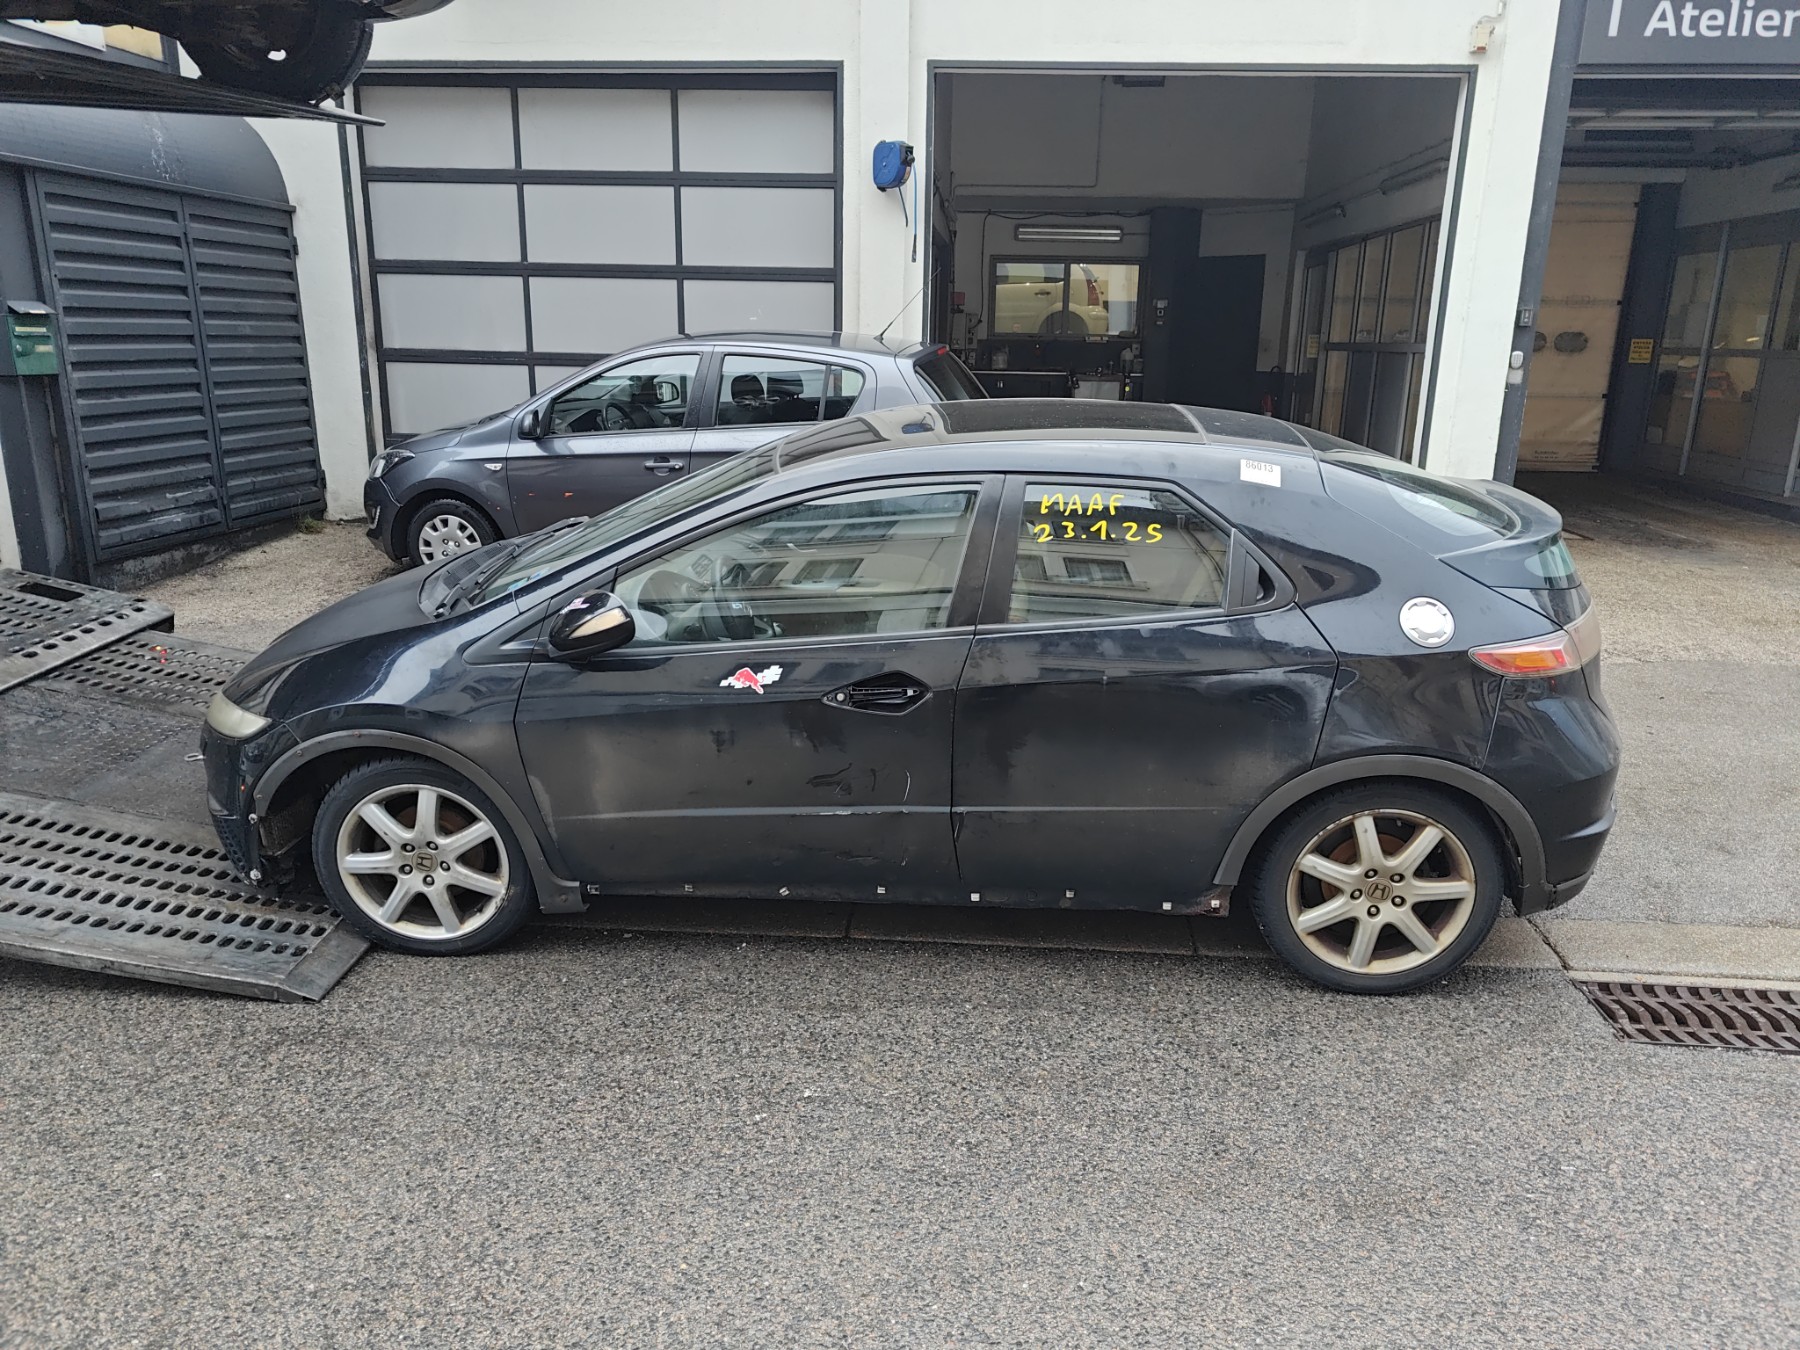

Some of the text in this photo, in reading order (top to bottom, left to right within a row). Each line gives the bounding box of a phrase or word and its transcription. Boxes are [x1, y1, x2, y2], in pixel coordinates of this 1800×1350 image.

[1644, 0, 1800, 38] Atelier
[1245, 460, 1274, 473] 86013
[1040, 492, 1125, 516] MAAF
[1033, 519, 1163, 543] 23.1.25
